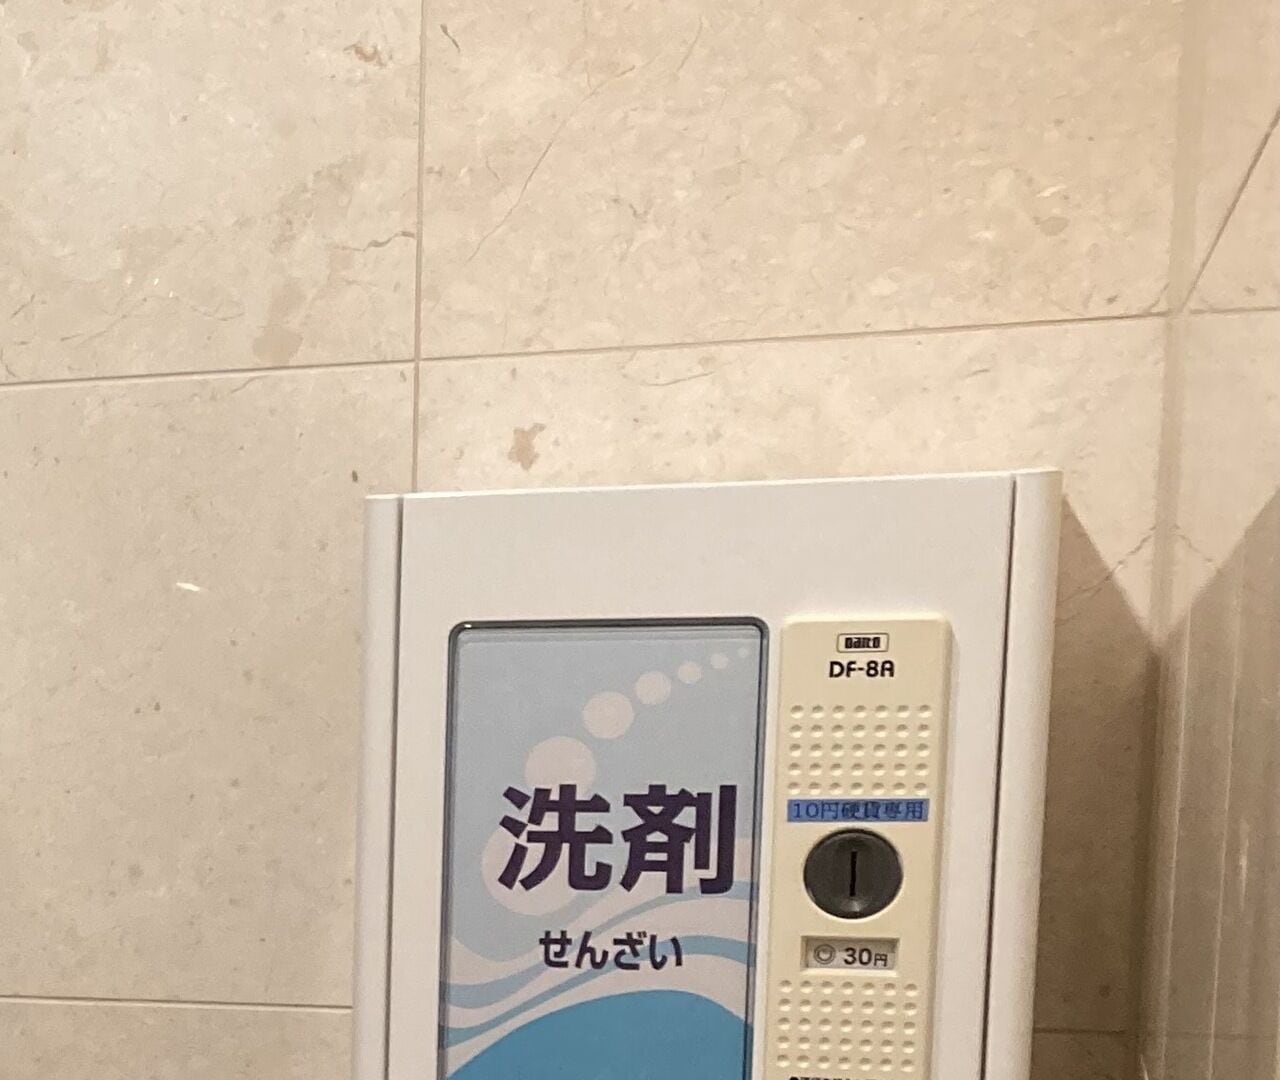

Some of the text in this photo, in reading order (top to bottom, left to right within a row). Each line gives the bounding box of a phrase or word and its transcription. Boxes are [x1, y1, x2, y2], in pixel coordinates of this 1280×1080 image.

[828, 660, 895, 678] DF-8A
[793, 801, 924, 820] 10円硬貨専用
[497, 784, 737, 895] 洗剤
[539, 930, 685, 970] せんざい
[843, 946, 888, 967] 30円
